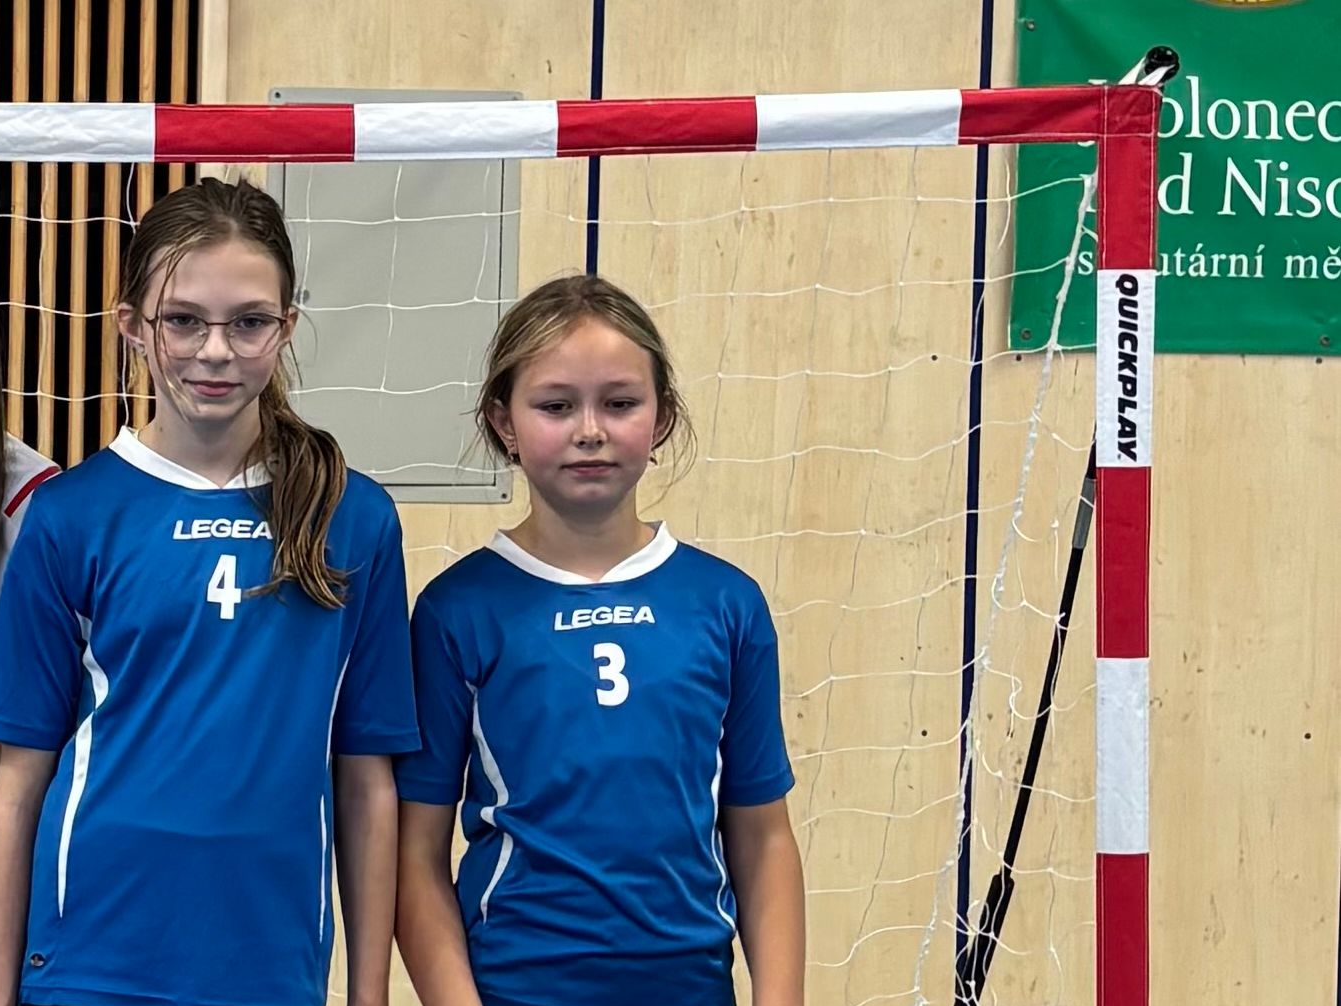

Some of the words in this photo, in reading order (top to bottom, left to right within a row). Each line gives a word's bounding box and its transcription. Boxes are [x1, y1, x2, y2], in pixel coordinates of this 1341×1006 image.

[1115, 273, 1139, 462] QUICKPLAY
[173, 518, 273, 540] LEGEA
[207, 554, 242, 620] 4
[554, 605, 656, 631] LEGEA
[593, 642, 629, 706] 3
